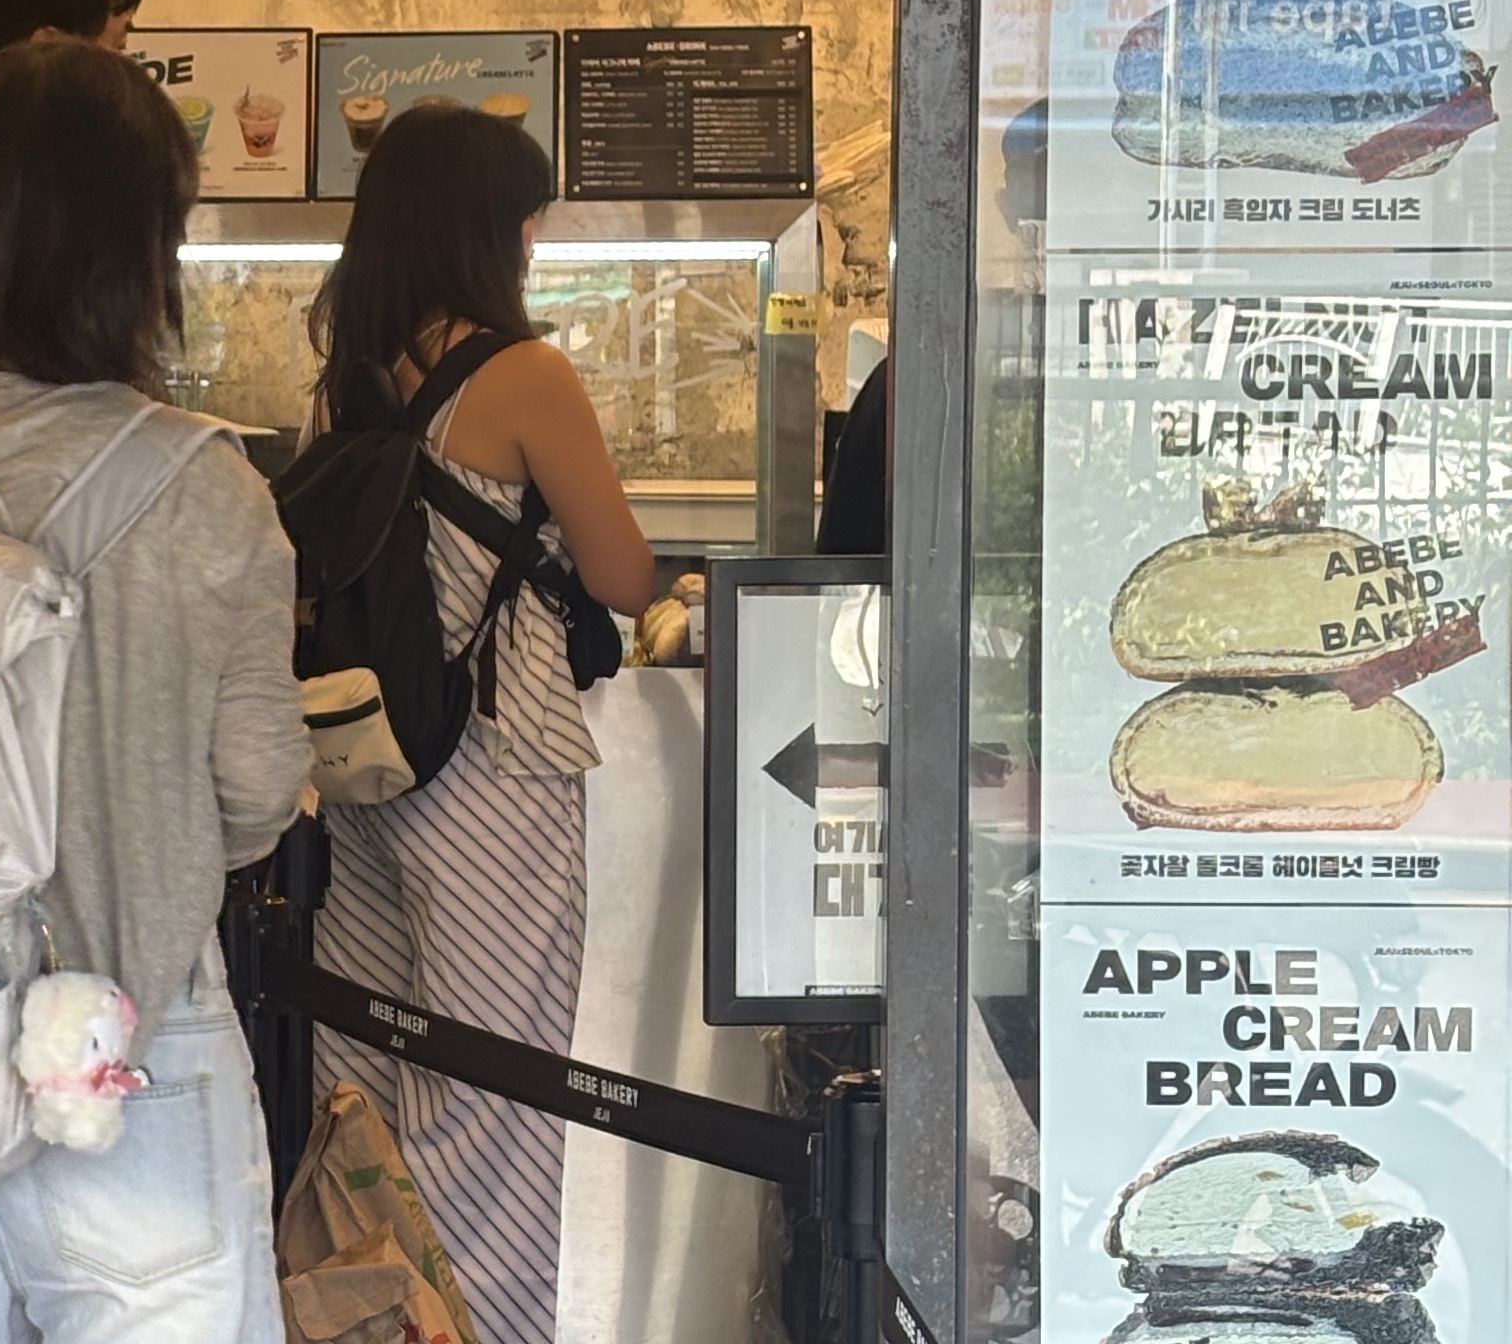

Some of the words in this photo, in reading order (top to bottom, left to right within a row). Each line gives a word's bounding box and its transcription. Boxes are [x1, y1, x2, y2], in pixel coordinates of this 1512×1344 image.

[1334, 0, 1476, 53] ABEBE
[338, 52, 484, 96] Signature
[1364, 37, 1456, 84] AND
[1147, 198, 1216, 223] 가시리
[1222, 198, 1293, 223] 흑임자
[1298, 198, 1344, 222] 크림
[1351, 197, 1421, 222] 도너츠
[1240, 352, 1493, 400] CREAM
[1323, 533, 1463, 582] ABEBE
[1354, 570, 1444, 611] AND
[1320, 594, 1486, 652] BAKERY
[1272, 855, 1364, 879] 헤이즐넛
[1371, 855, 1441, 879] 크림빵
[1083, 949, 1318, 996] APPLE
[368, 997, 395, 1025] ABEBE
[397, 1009, 429, 1038] BAKERY
[1223, 1005, 1472, 1052] CREAM
[567, 1068, 598, 1097] ABEBE
[600, 1078, 639, 1109] BAKERY
[1146, 1061, 1397, 1107] BREAD
